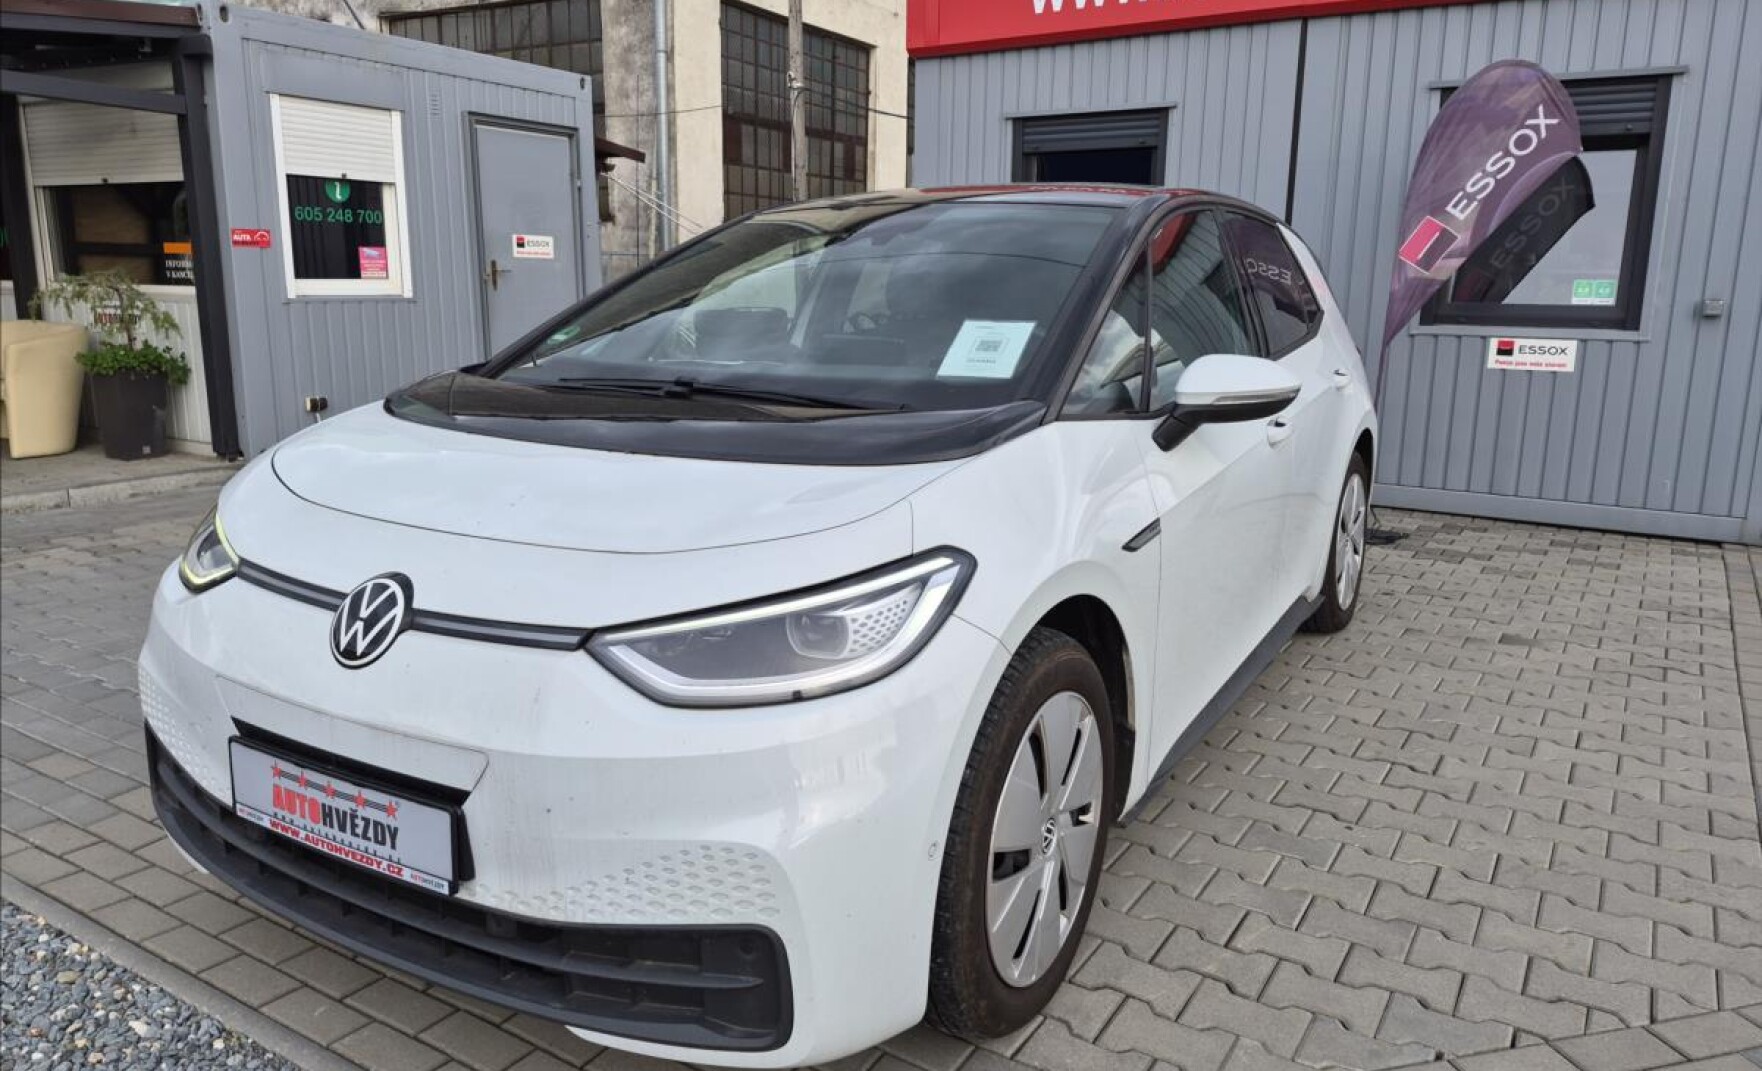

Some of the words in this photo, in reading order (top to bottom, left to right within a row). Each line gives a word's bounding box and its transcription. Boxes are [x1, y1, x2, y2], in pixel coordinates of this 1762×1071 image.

[1445, 104, 1560, 220] ESSOX
[294, 206, 323, 221] 605
[327, 207, 353, 223] 248
[357, 209, 383, 223] 700
[1490, 177, 1576, 269] ESSOX
[1518, 344, 1568, 356] ESSOX
[334, 578, 402, 660] VW
[269, 818, 404, 878] WWW.AUTOHVEZDY.CZ
[272, 784, 398, 851] AUTOHVĚZDY
